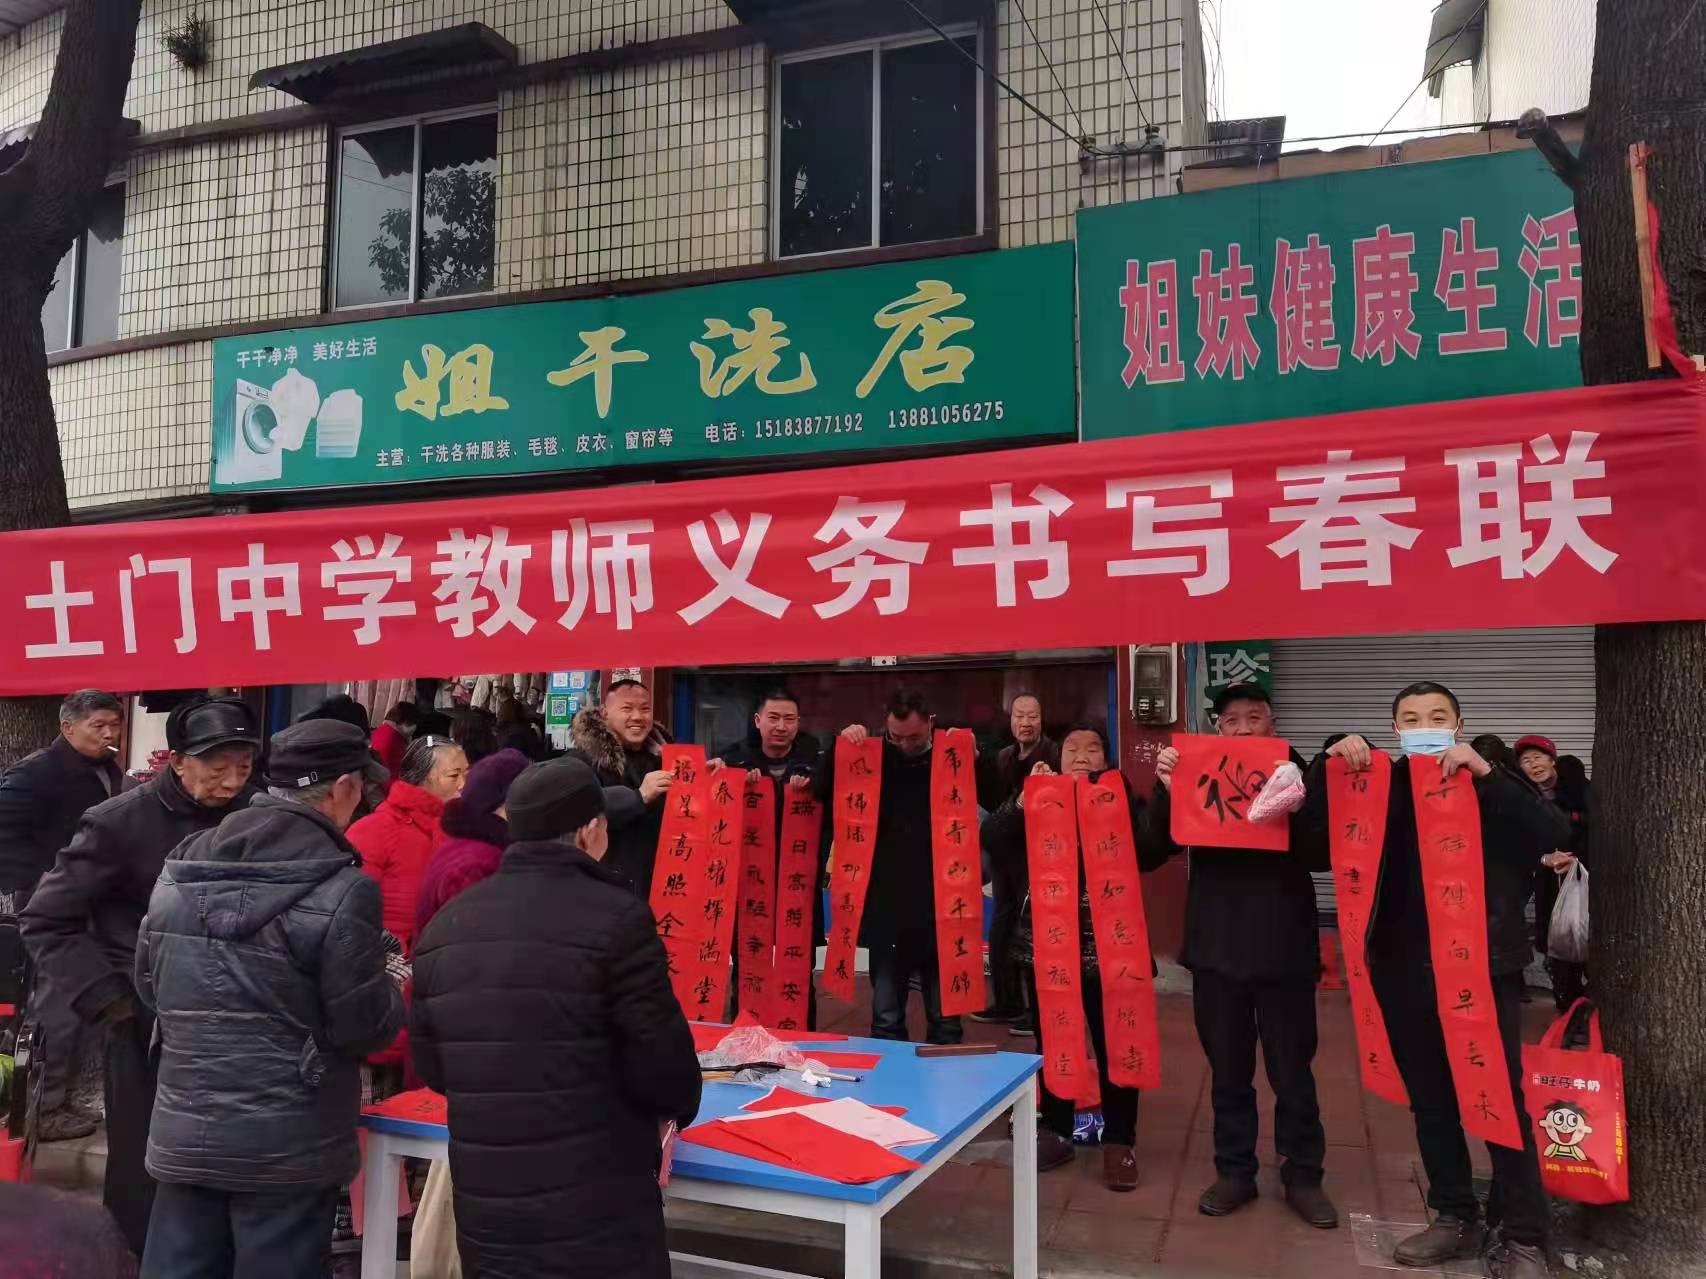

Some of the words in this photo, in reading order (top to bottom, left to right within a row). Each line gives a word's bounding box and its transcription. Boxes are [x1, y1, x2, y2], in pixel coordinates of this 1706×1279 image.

[1119, 206, 1583, 388] 姐妹健康生活
[236, 346, 297, 368] 干干净净
[312, 337, 377, 360] 美好生活
[888, 401, 1004, 429] 13881056275
[25, 430, 1621, 659] 土门中学教师义务书写春联
[1210, 649, 1270, 686] 珍
